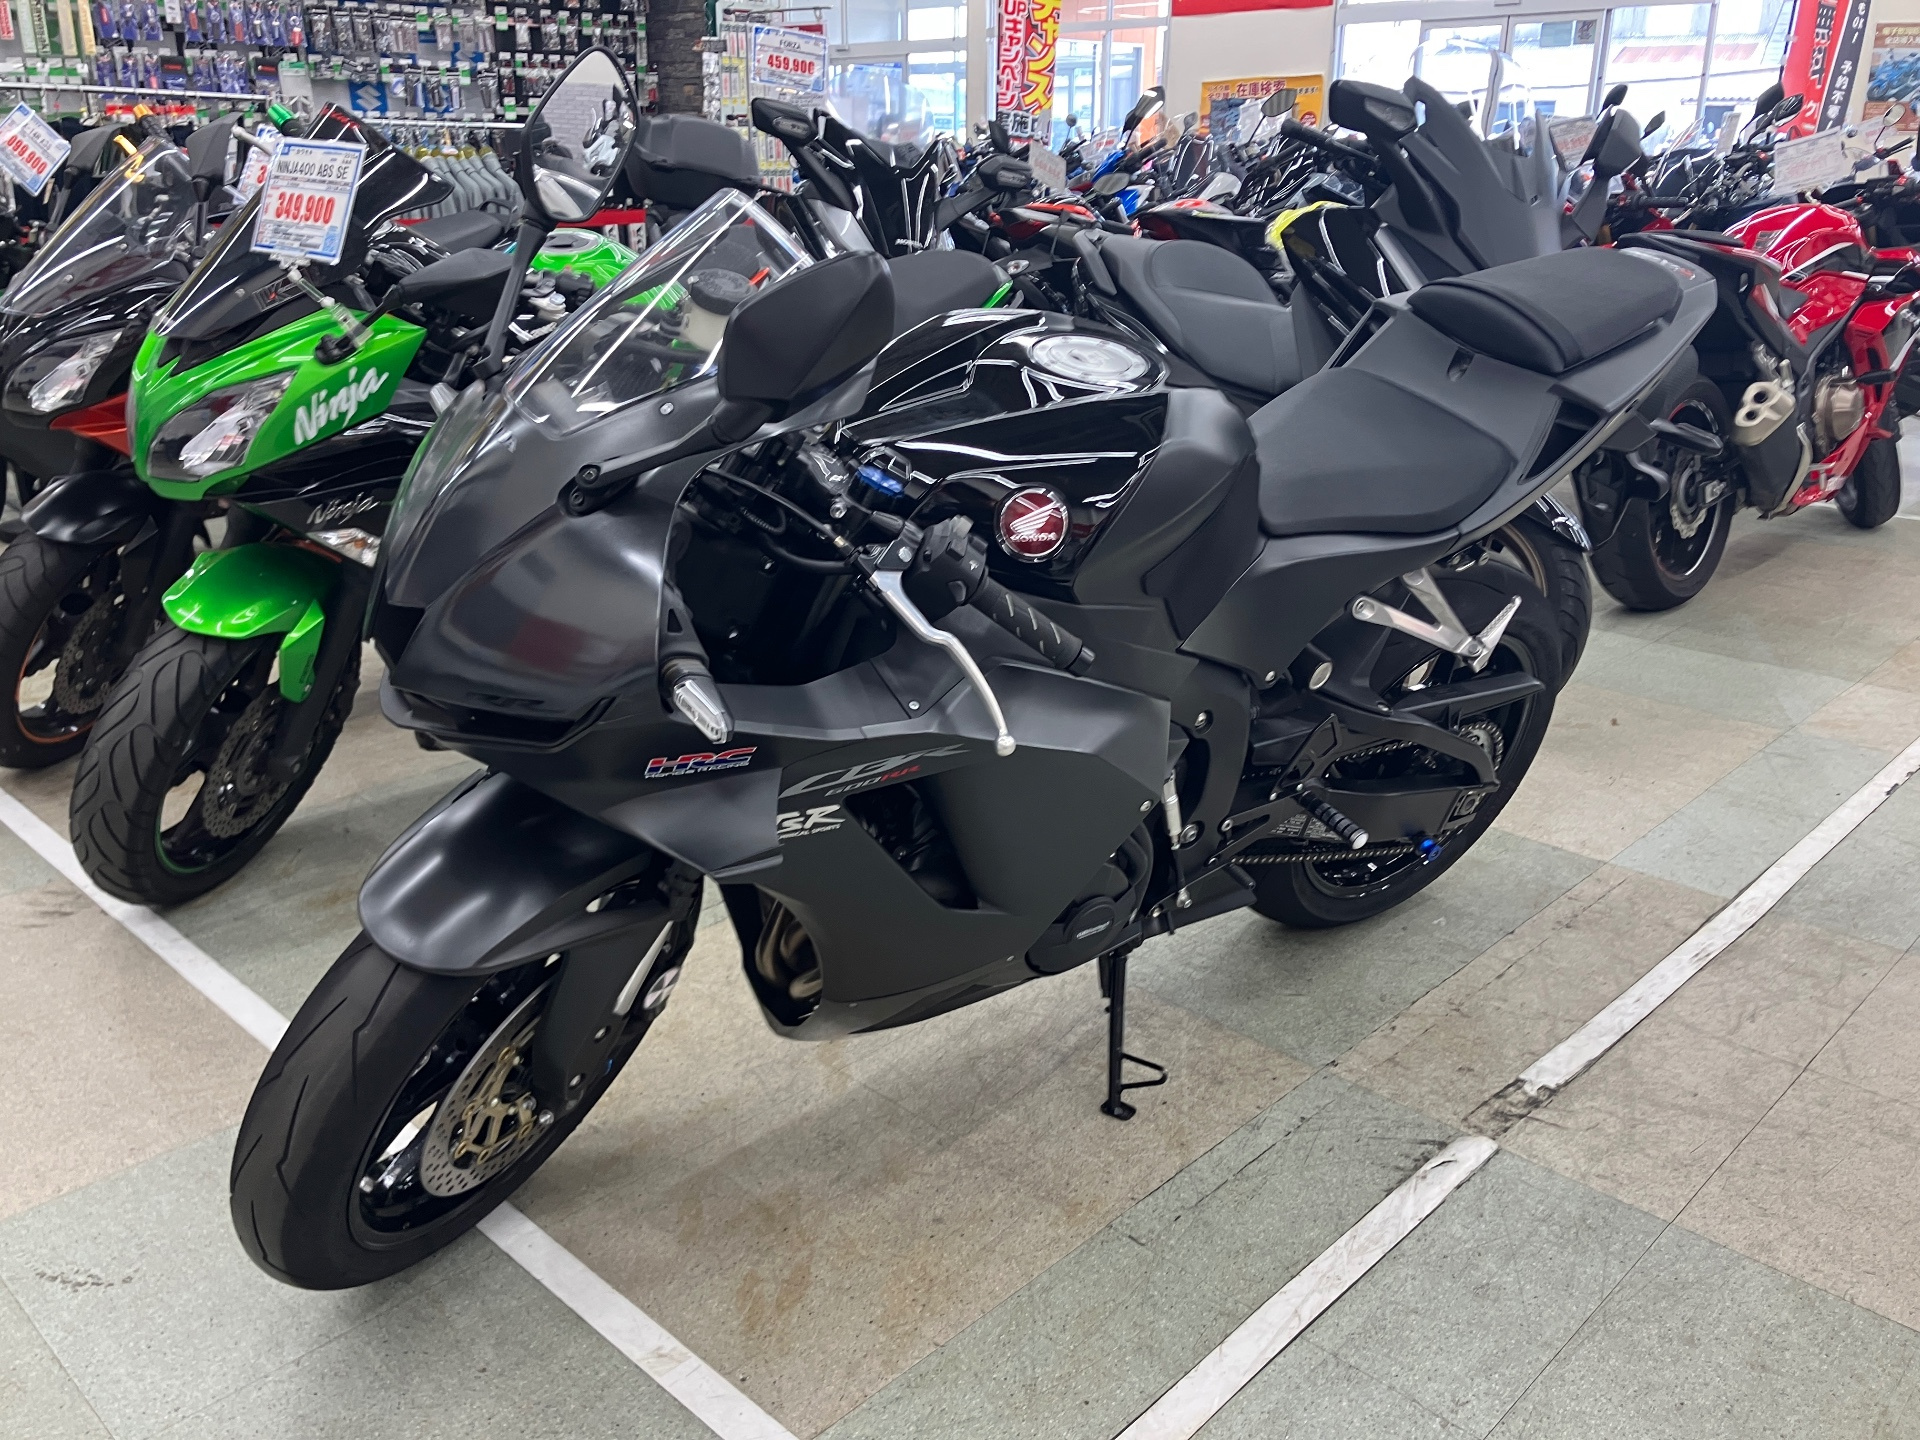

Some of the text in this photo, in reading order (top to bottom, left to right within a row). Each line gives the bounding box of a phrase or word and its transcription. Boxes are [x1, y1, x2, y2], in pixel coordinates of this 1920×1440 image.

[277, 160, 350, 180] NINJA400 ABS SE
[275, 191, 335, 225] 349,900
[293, 366, 390, 446] Ninja
[306, 491, 381, 525] Ninja
[1009, 532, 1058, 543] HONDA
[644, 746, 758, 775] HRC
[777, 743, 972, 799] CBR
[824, 765, 921, 798] 600RR
